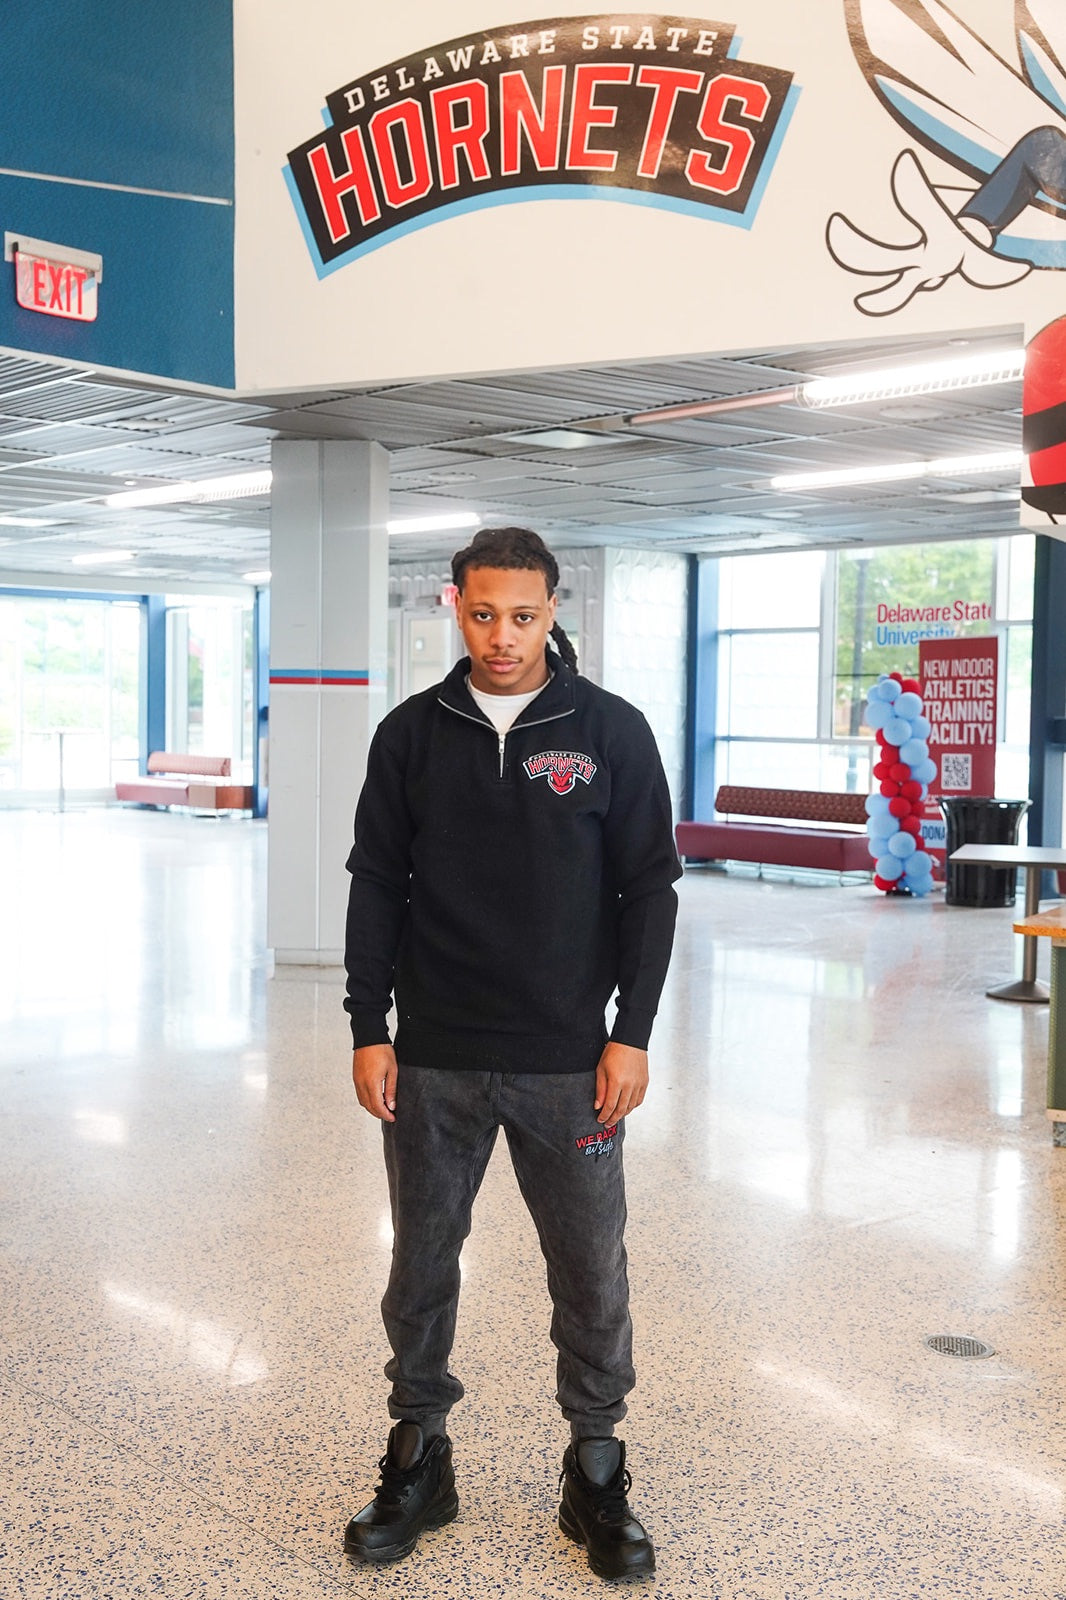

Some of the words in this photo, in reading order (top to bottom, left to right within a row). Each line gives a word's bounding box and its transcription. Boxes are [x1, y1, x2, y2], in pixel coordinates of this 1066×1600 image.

[343, 30, 558, 114] DELAWARE
[582, 25, 719, 56] STATE
[307, 63, 772, 245] HORNETS
[33, 262, 88, 315] EXIT
[877, 603, 951, 624] Delaware
[923, 660, 949, 678] NEW
[951, 658, 994, 677] INDOOR
[923, 679, 994, 699] ATHLETICS
[923, 700, 994, 722] TRAINING
[929, 722, 994, 745] ACILITY!
[528, 756, 594, 779] HORNETS
[575, 1135, 595, 1149] WE
[596, 1125, 617, 1142] BACK
